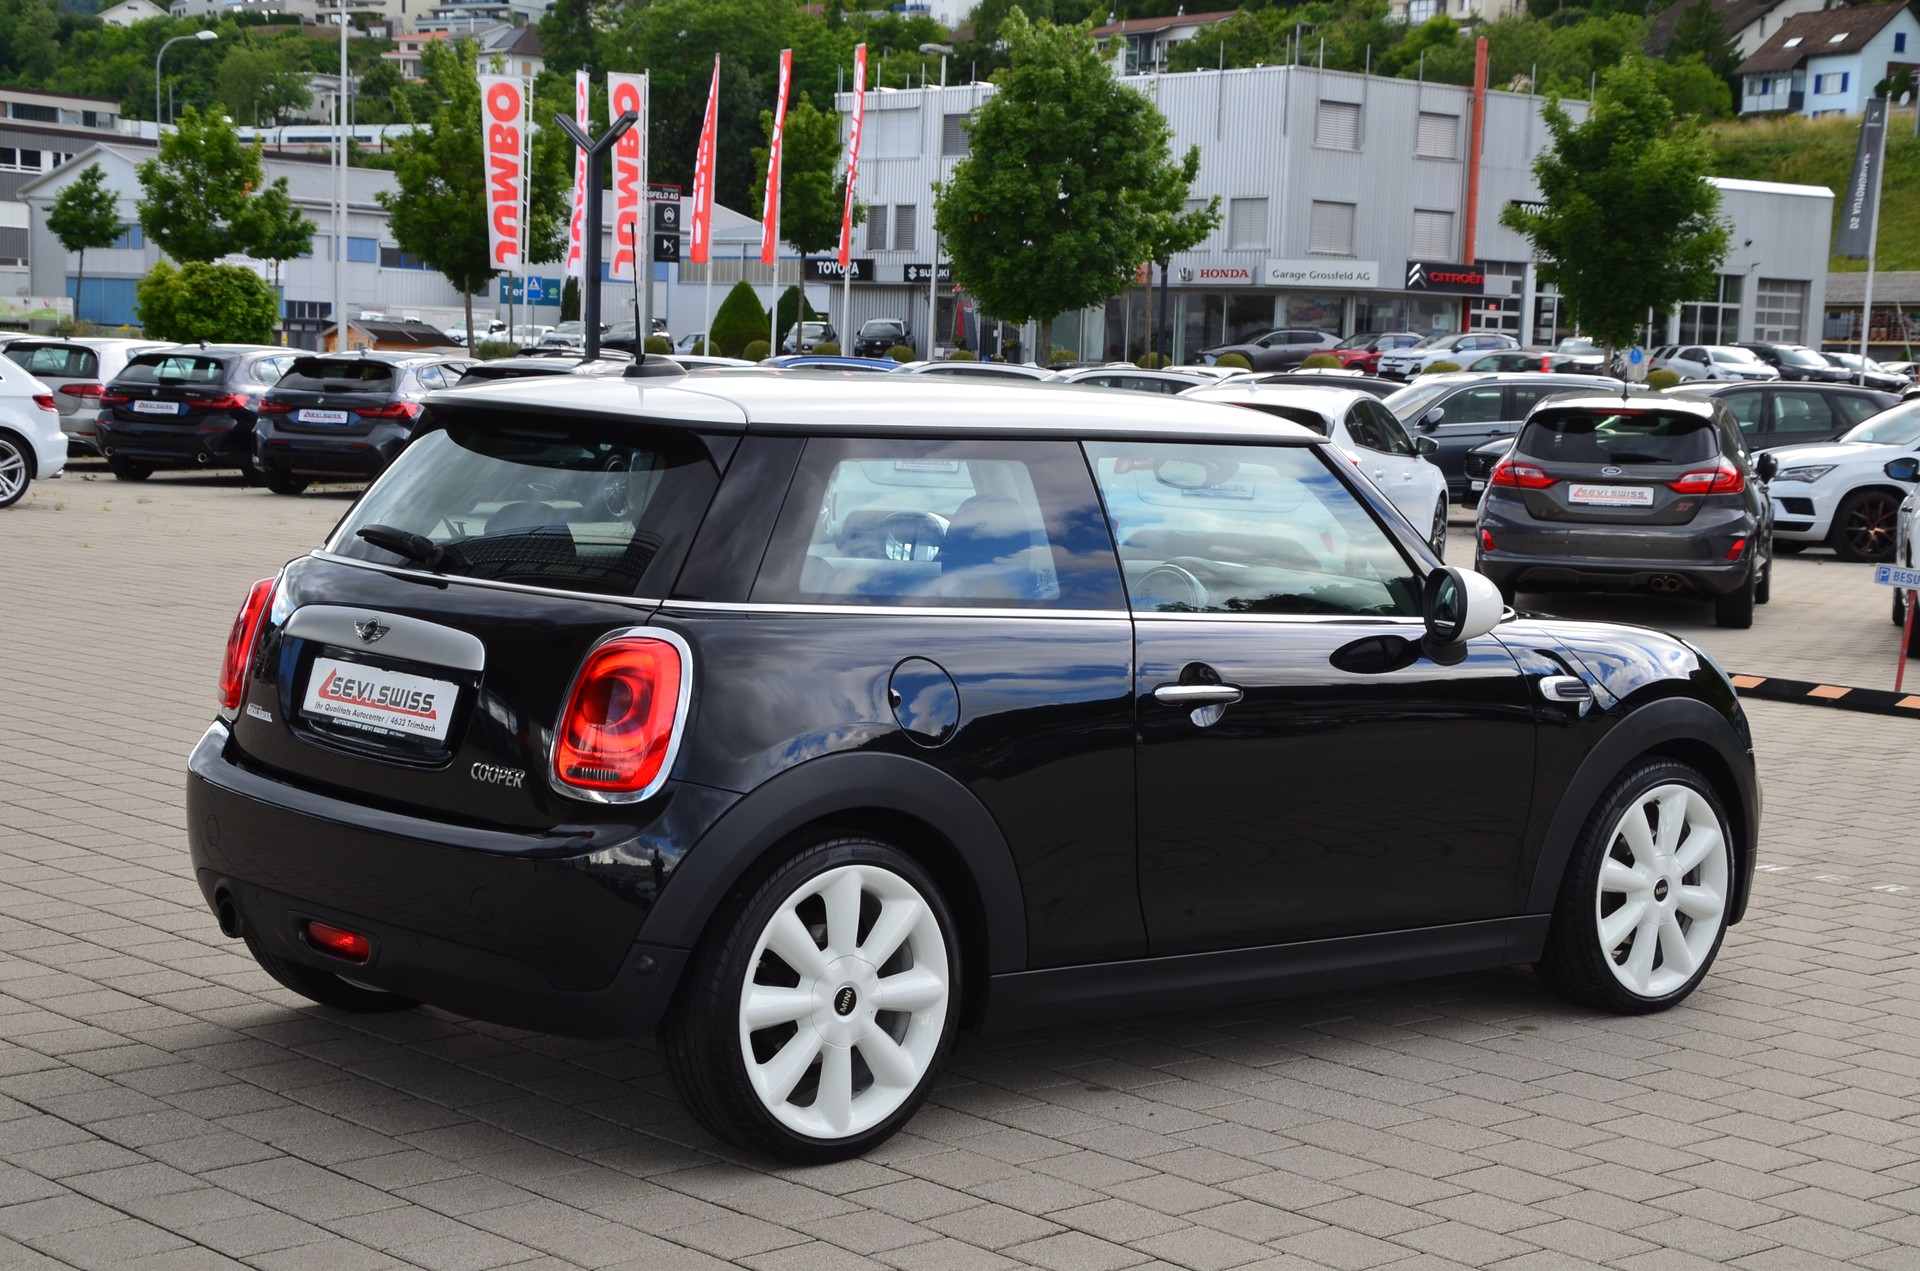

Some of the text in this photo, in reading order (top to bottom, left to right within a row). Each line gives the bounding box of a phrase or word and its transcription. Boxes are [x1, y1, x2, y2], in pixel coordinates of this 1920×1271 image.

[817, 261, 859, 274] TOYOA
[919, 268, 949, 278] SUUKI
[1200, 269, 1249, 278] HONDA
[1272, 270, 1370, 281] Garage Grossfeld AG
[1581, 489, 1645, 498] SEVI SWISS
[330, 676, 435, 713] SEVI SWISS
[314, 701, 323, 709] Ihr
[352, 709, 385, 722] Autocenter
[390, 716, 406, 727] 4632
[407, 719, 436, 732] Trimbach
[470, 762, 526, 788] COOPER
[839, 989, 853, 1013] MINI
